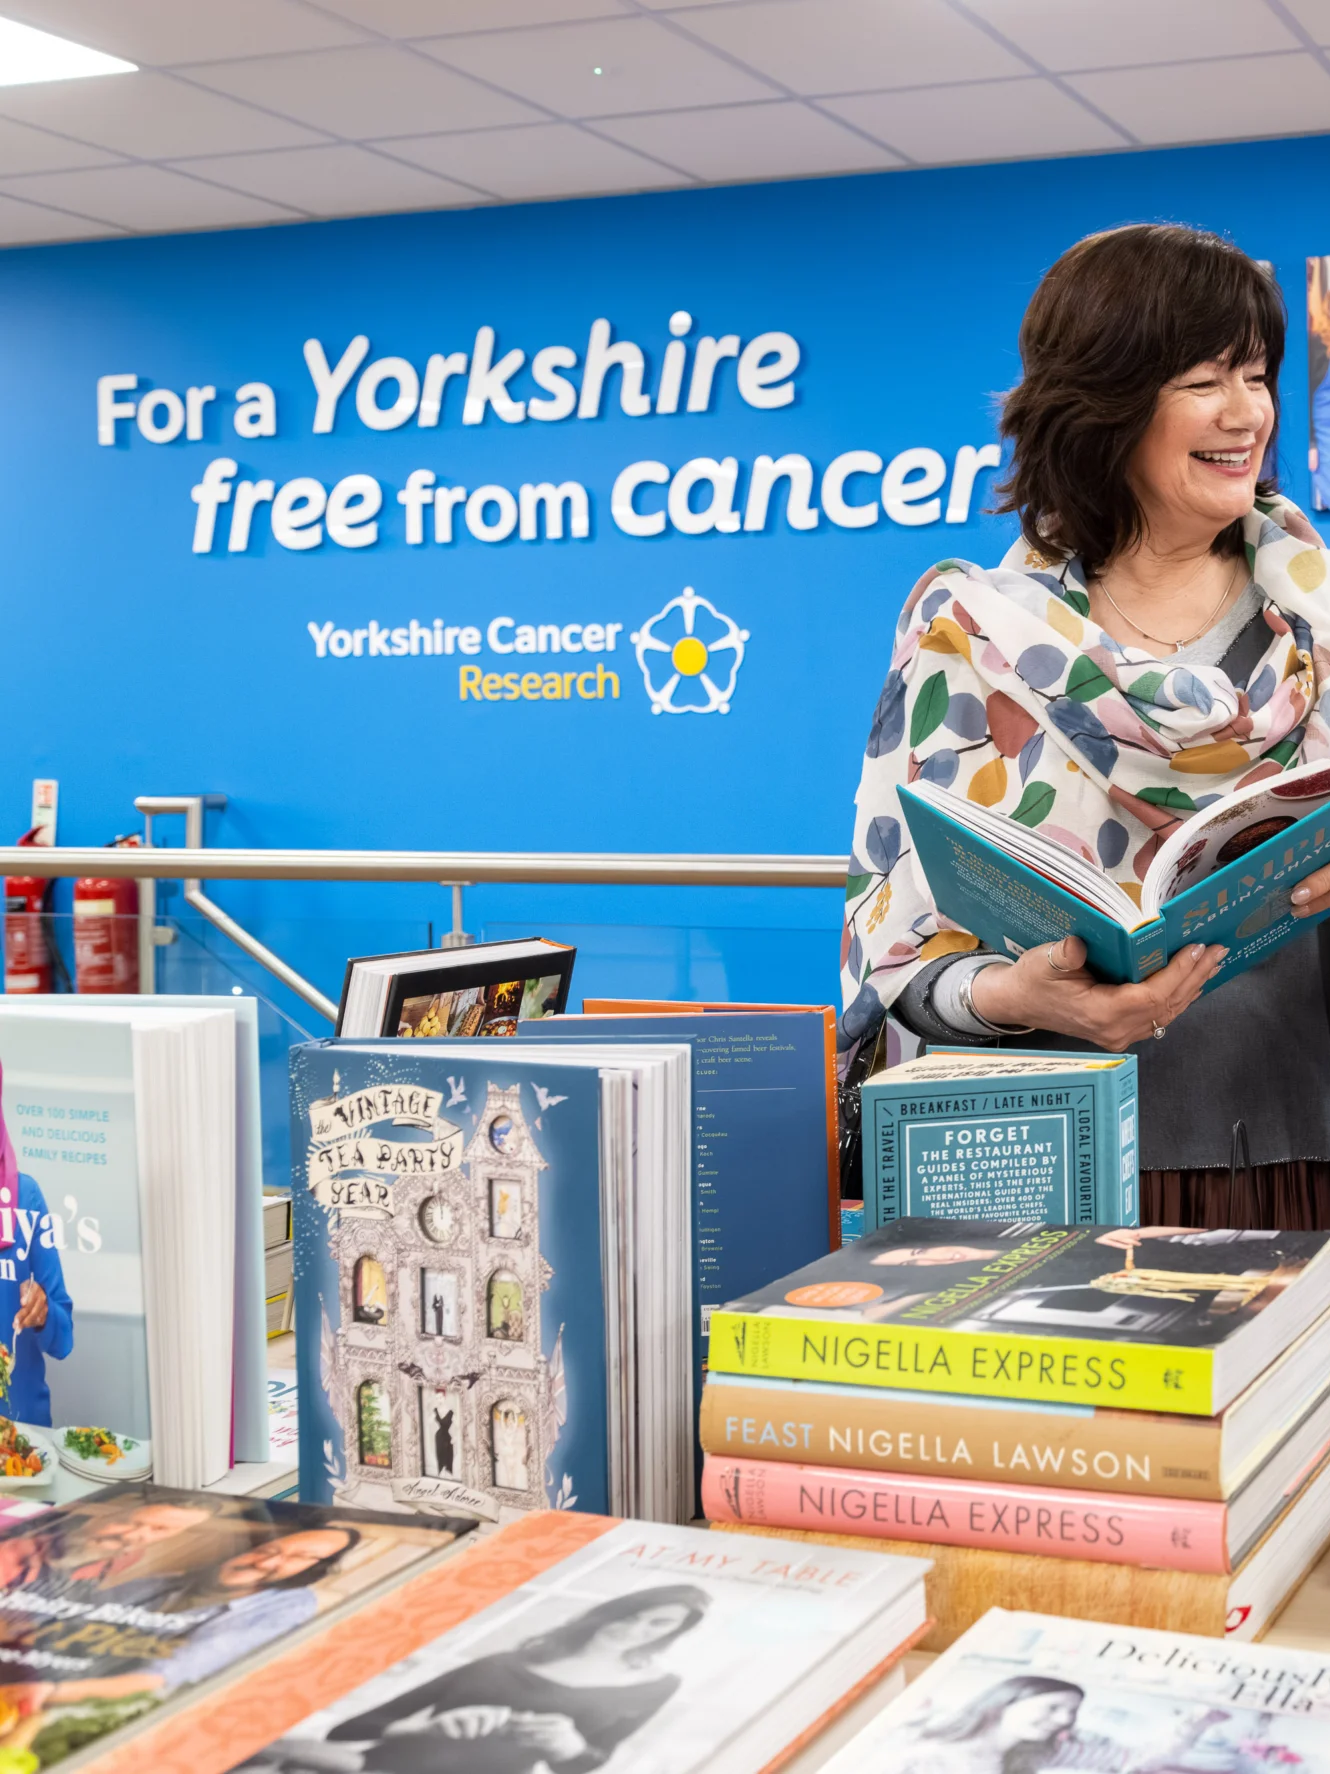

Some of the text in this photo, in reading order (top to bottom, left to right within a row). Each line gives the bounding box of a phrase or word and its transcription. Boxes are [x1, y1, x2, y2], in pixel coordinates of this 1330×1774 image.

[96, 309, 801, 446] For a Yorkshire
[190, 442, 1001, 554] free from cancer
[307, 614, 623, 659] Yorkshire Cancer
[457, 662, 622, 702] Research
[1182, 884, 1265, 938] SABRINA
[708, 1035, 726, 1043] Chris
[728, 1034, 753, 1042] Santella
[731, 1045, 750, 1053] famed
[769, 1044, 796, 1052] festivals,
[701, 1055, 716, 1063] craft
[16, 1104, 110, 1123] OVER 100 SIMPLE
[333, 1089, 437, 1128] VINTAGE
[900, 1098, 977, 1116] BREAKFAST
[994, 1096, 1025, 1110] LATE
[1031, 1092, 1071, 1107] NIGHT
[21, 1126, 107, 1144] AND DELICIOUS
[881, 1121, 895, 1170] TRAVEL
[945, 1126, 1030, 1146] FORGET
[22, 1147, 107, 1166] FAMILY RECIPES
[318, 1140, 456, 1173] TEA PARTY
[917, 1155, 1058, 1175] GUIDES COMPILED BY
[922, 1142, 1052, 1162] THE RESTAURANT
[921, 1167, 1054, 1184] A PANEL OF MYSTERIOUS
[1078, 1109, 1093, 1222] LOCAL FAVOURITE
[330, 1181, 390, 1208] YEAR
[882, 1175, 896, 1201] THE
[922, 1191, 992, 1202] INTERNATIONAL
[994, 1187, 1022, 1196] GUIDE
[1025, 1186, 1035, 1194] BY
[924, 1176, 1052, 1194] EXPERTS, THIS IS THE FIRST
[930, 1201, 950, 1209] REAL
[995, 1196, 1015, 1204] OVER
[947, 1206, 981, 1215] WORLD'S
[984, 1203, 1017, 1212] LEADING
[981, 1210, 1020, 1219] FAVOURITE
[0, 1187, 104, 1261] iya's
[900, 1269, 998, 1320] NIGELLA
[997, 1229, 1069, 1274] EXPRESS
[801, 1334, 1128, 1391] NIGELLA EXPRESS
[725, 1416, 1152, 1482] FEAST NIGELLA LAWSON
[798, 1485, 1126, 1546] NIGELLA EXPRESS
[618, 1544, 668, 1560] AT
[675, 1551, 742, 1569] MY
[750, 1559, 863, 1588] TABLE
[1227, 1682, 1315, 1714] Ella
